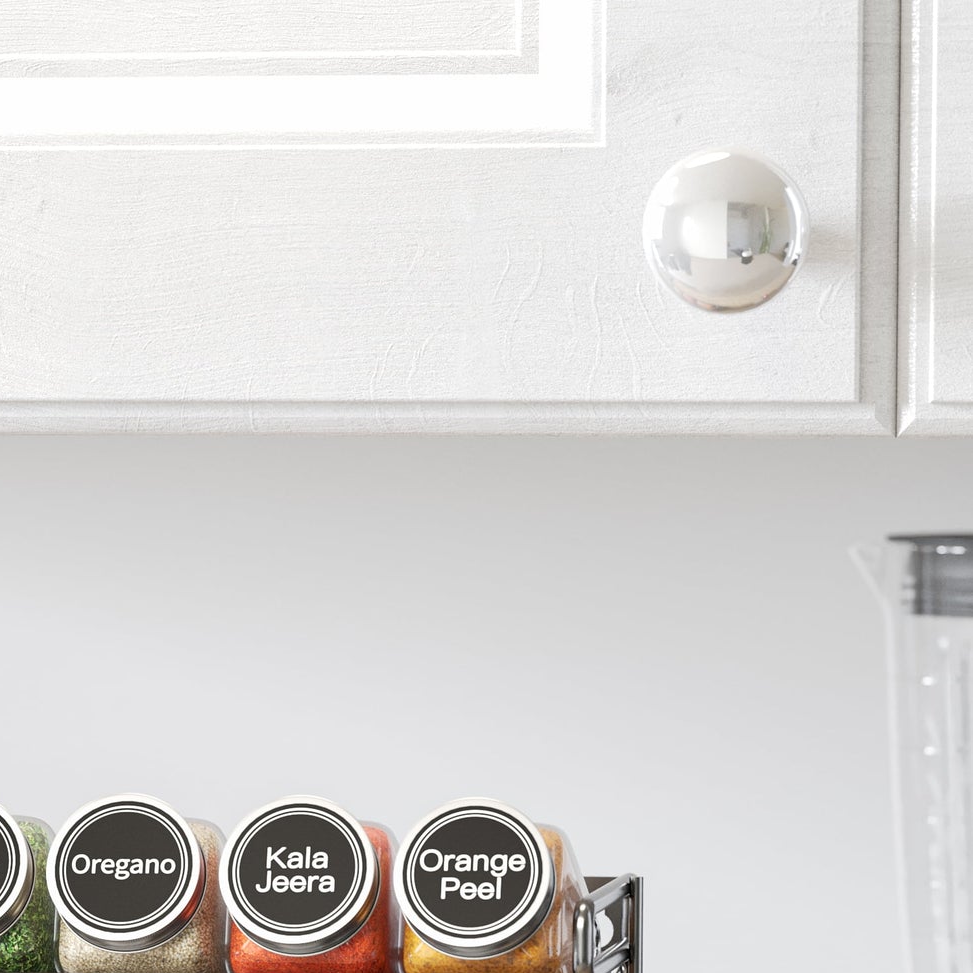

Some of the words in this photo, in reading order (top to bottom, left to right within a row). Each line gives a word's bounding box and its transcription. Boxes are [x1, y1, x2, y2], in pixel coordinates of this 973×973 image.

[71, 853, 176, 881] Oregano
[265, 845, 329, 870] Kala
[419, 848, 526, 877] Orange
[255, 869, 336, 894] Jeera
[440, 876, 502, 900] Peel
